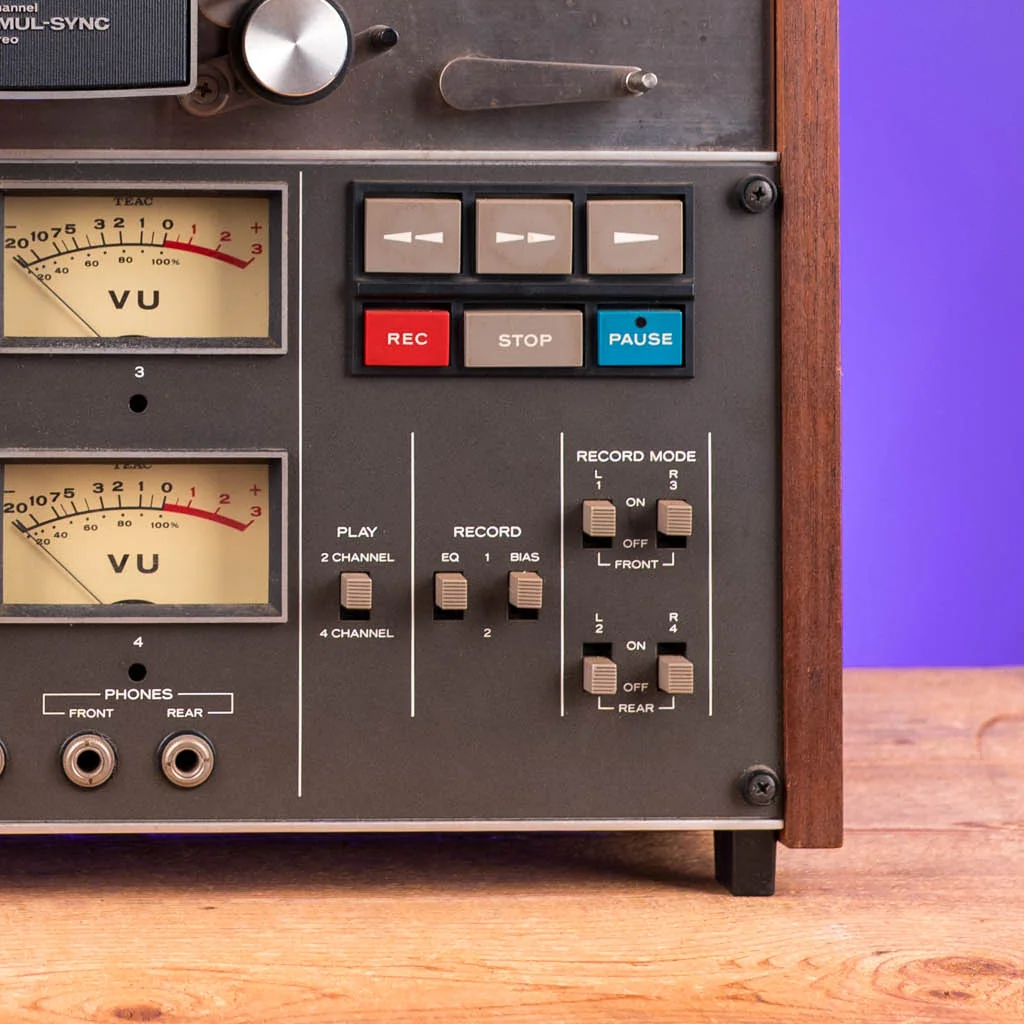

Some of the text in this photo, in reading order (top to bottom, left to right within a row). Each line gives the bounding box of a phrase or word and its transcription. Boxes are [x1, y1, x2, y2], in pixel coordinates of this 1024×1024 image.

[113, 196, 153, 206] TEAC
[5, 239, 29, 249] 20
[31, 231, 49, 242] 10
[52, 228, 62, 238] 7
[65, 224, 76, 234] 5
[94, 219, 105, 229] 3
[114, 218, 125, 228] 2
[162, 219, 174, 230] 0
[109, 290, 160, 309] VU
[387, 333, 674, 347] REC STOP PAUSE
[134, 366, 145, 377] 3
[576, 451, 697, 462] RECORD MODE
[594, 470, 603, 478] L
[668, 470, 679, 478] R
[669, 481, 678, 490] 3
[625, 498, 646, 507] ON
[336, 527, 378, 537] PLAY
[453, 526, 522, 537] RECORD
[622, 539, 649, 548] OFF
[320, 553, 395, 562] 2 CHANNEL
[441, 553, 460, 562] EQ
[510, 552, 540, 562] BIAS
[108, 554, 159, 573] VU
[614, 560, 659, 569] FRONT
[595, 613, 604, 622] L
[668, 613, 679, 621] R
[483, 628, 492, 637] 2
[595, 624, 604, 633] 2
[668, 624, 678, 632] 4
[319, 629, 395, 638] 4 CHANNEL
[132, 637, 144, 647] 4
[625, 641, 646, 650] ON
[622, 683, 649, 692] OFF
[104, 689, 174, 700] PHONES
[166, 708, 204, 717] REAR
[618, 704, 655, 712] REAR
[68, 709, 115, 718] FRONT
